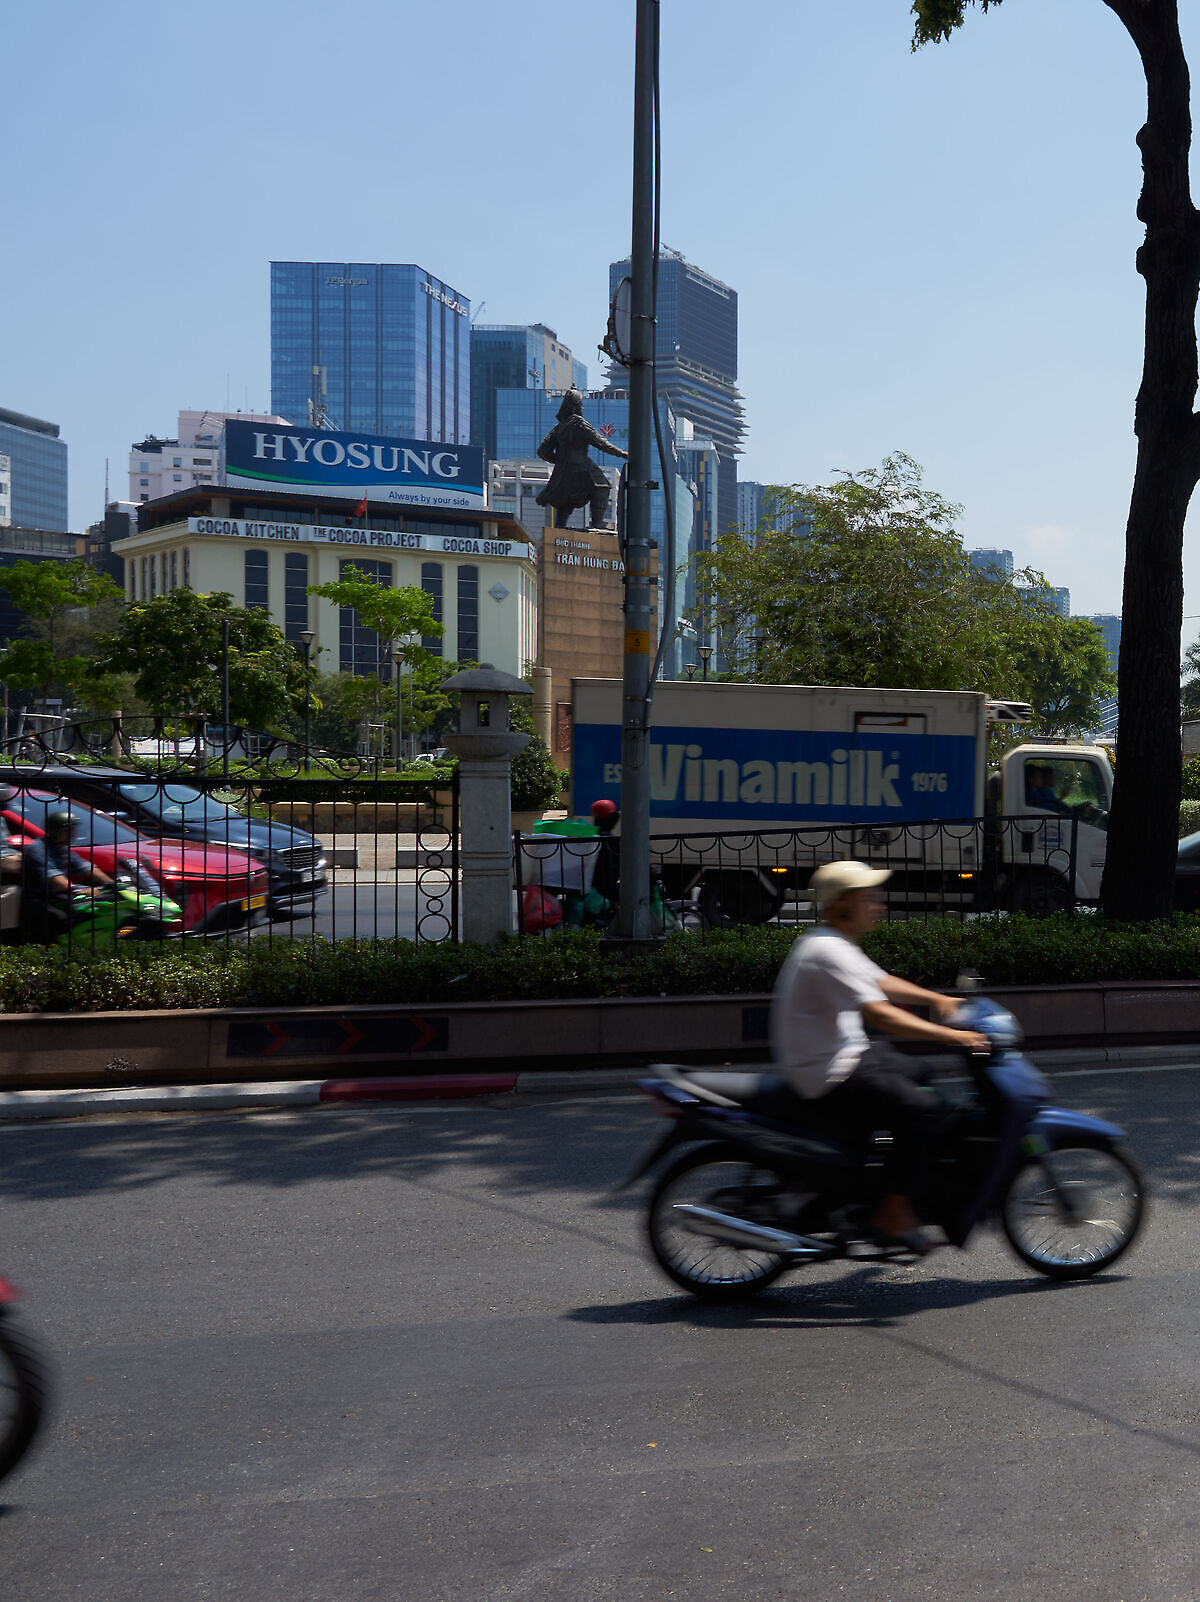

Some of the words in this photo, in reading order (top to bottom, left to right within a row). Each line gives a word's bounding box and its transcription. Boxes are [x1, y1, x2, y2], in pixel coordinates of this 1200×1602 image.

[423, 281, 440, 300] THE
[441, 292, 468, 317] NEXUS
[252, 432, 461, 479] HYOSUNG
[389, 491, 419, 503] Always
[421, 494, 431, 505] by
[433, 497, 452, 505] your
[453, 498, 470, 506] side
[197, 519, 239, 536] COCOA
[245, 523, 300, 540] KITCHEN
[313, 527, 327, 536] THE
[328, 528, 367, 544] COCOA
[370, 531, 422, 548] PROJECT
[443, 538, 480, 553] COCOA
[483, 541, 512, 556] SHOP
[612, 558, 625, 574] ĐẠ
[603, 763, 621, 784] ES
[650, 743, 902, 807] Vinamilk
[912, 772, 947, 793] 1976
